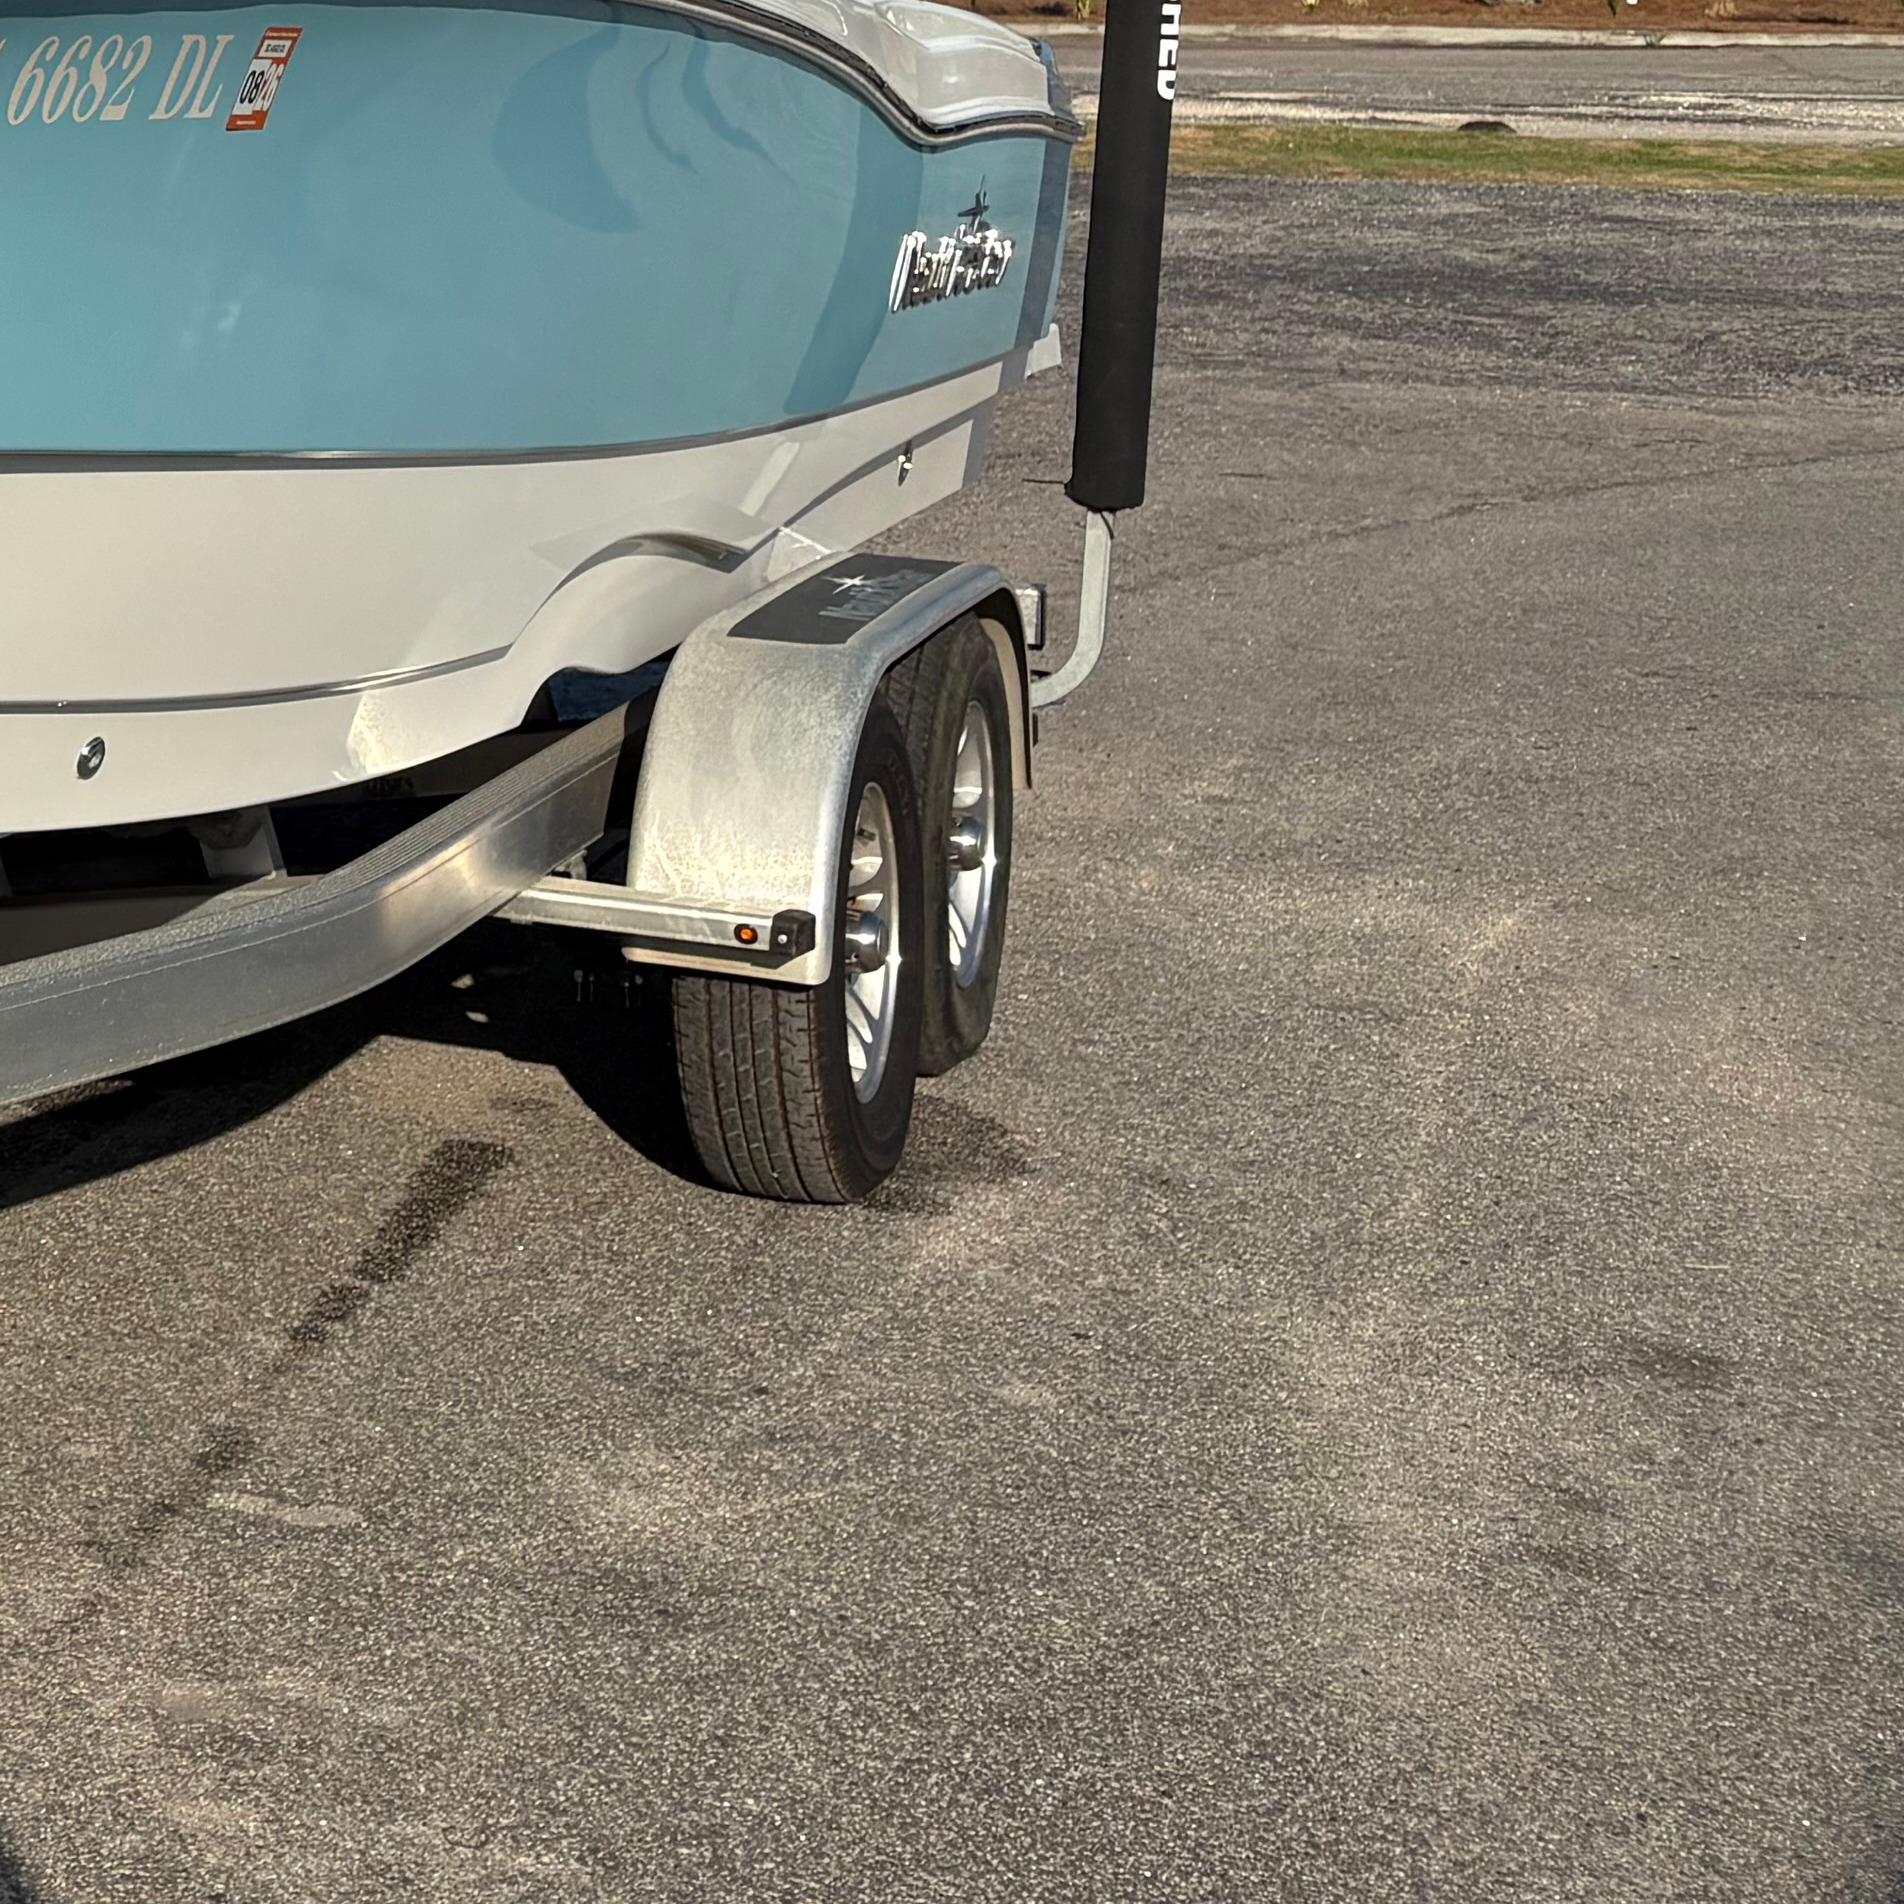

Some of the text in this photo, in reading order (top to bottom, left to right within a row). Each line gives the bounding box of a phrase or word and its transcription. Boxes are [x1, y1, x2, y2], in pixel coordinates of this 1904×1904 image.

[7, 33, 153, 126] 6682
[148, 34, 235, 121] DL
[239, 69, 265, 105] 08
